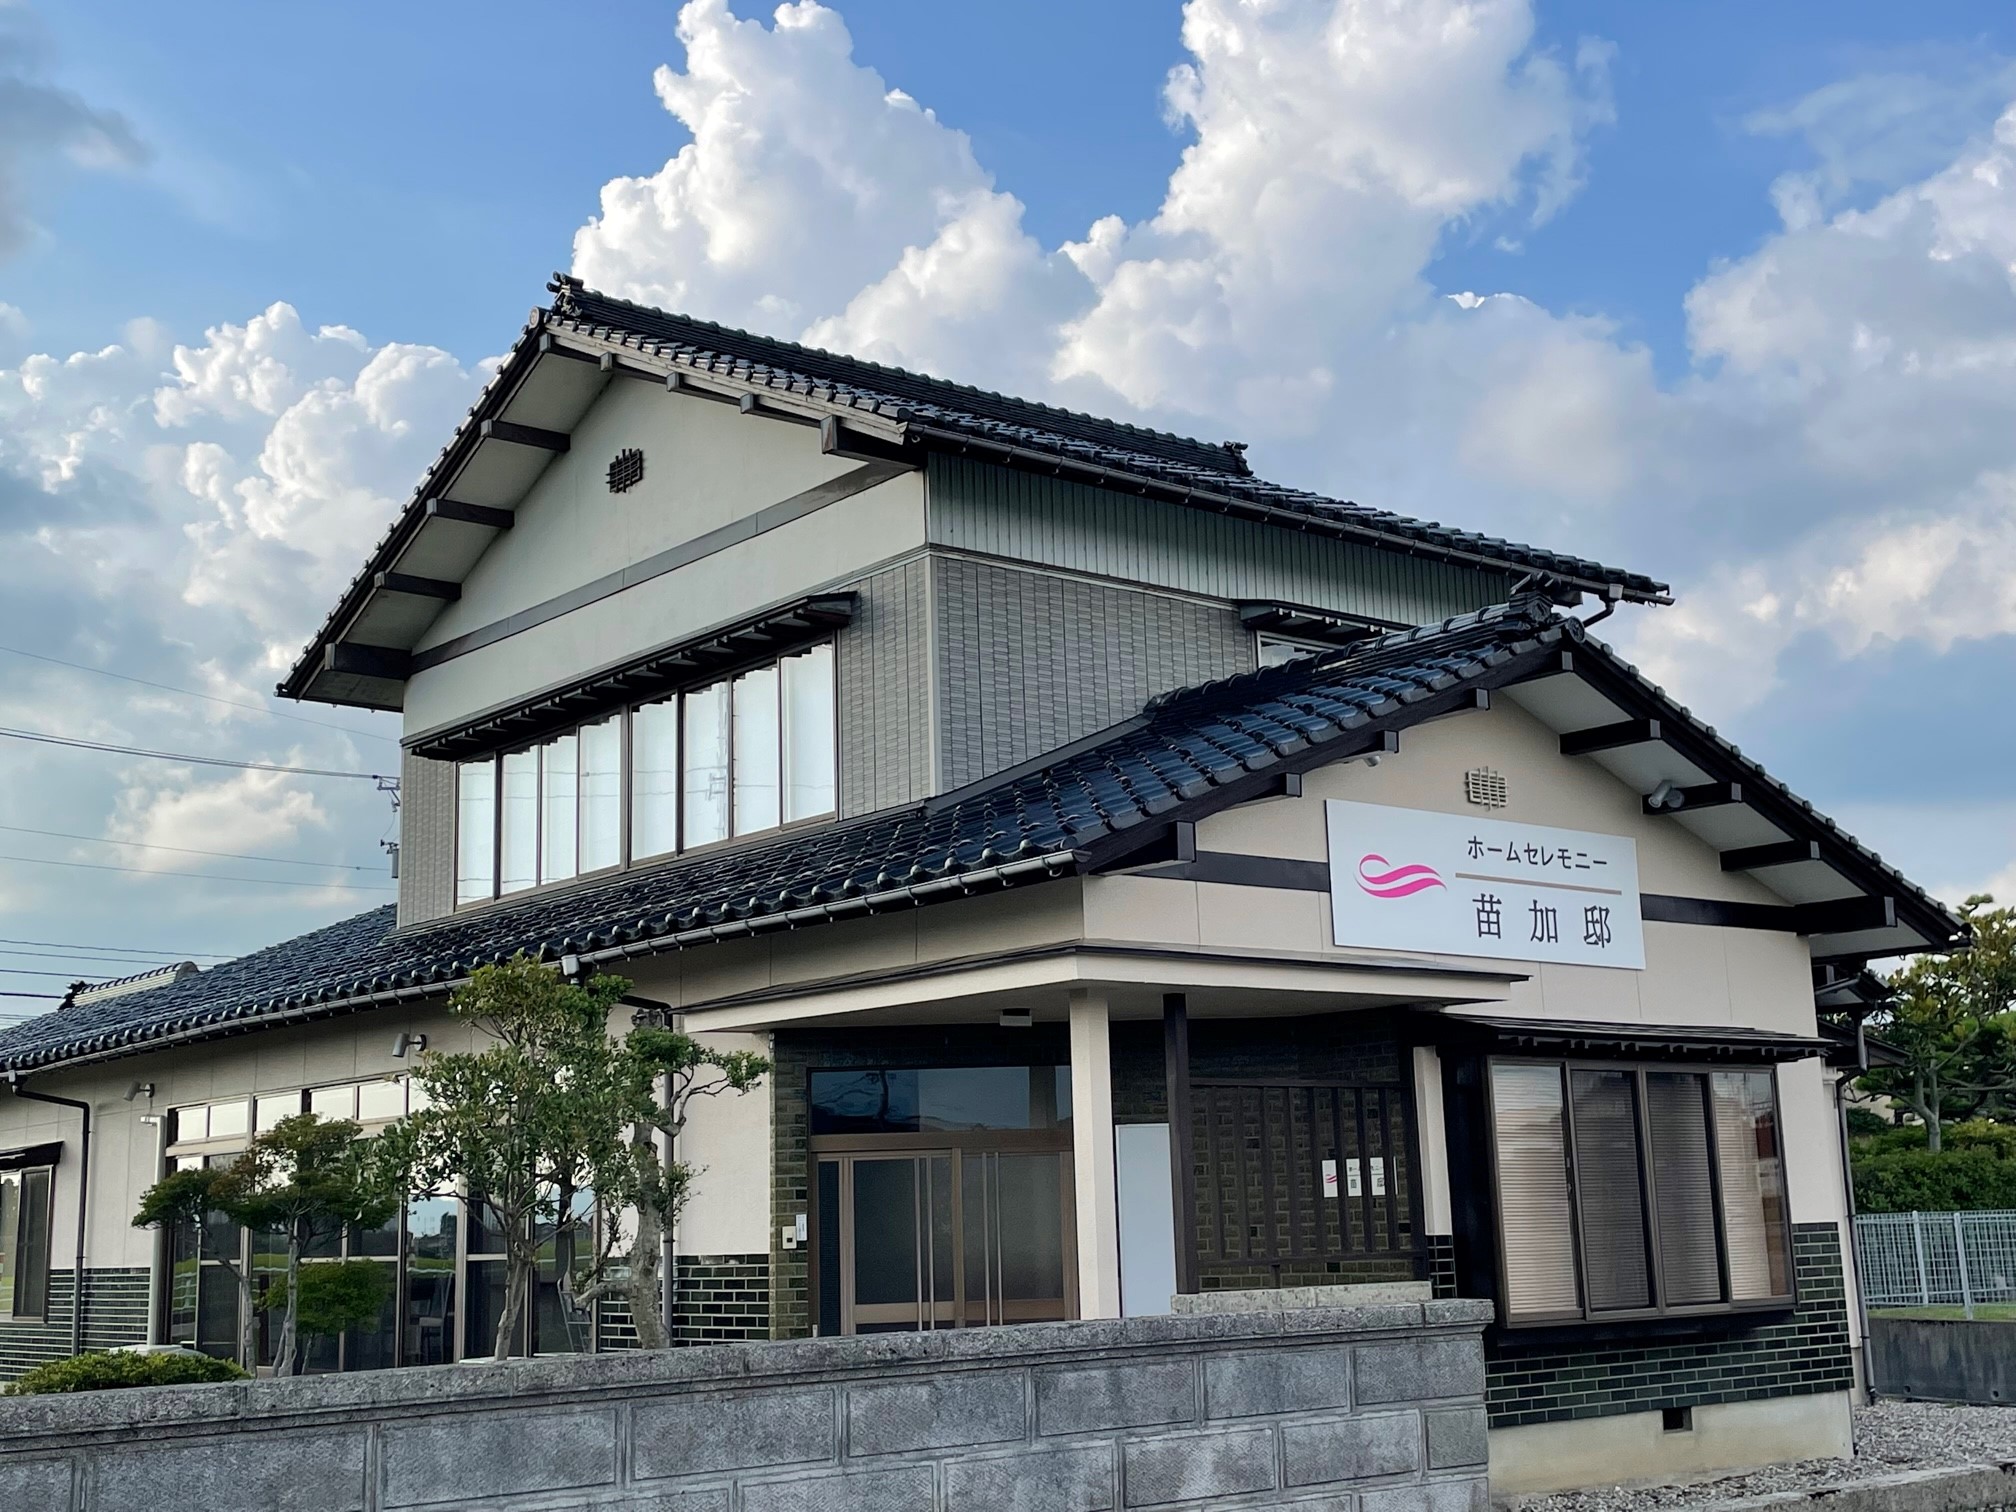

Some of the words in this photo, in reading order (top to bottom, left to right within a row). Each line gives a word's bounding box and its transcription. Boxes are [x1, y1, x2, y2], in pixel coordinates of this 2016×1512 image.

[1468, 836, 1607, 869] ホームセレモニー
[1473, 894, 1611, 948] 苗加邸
